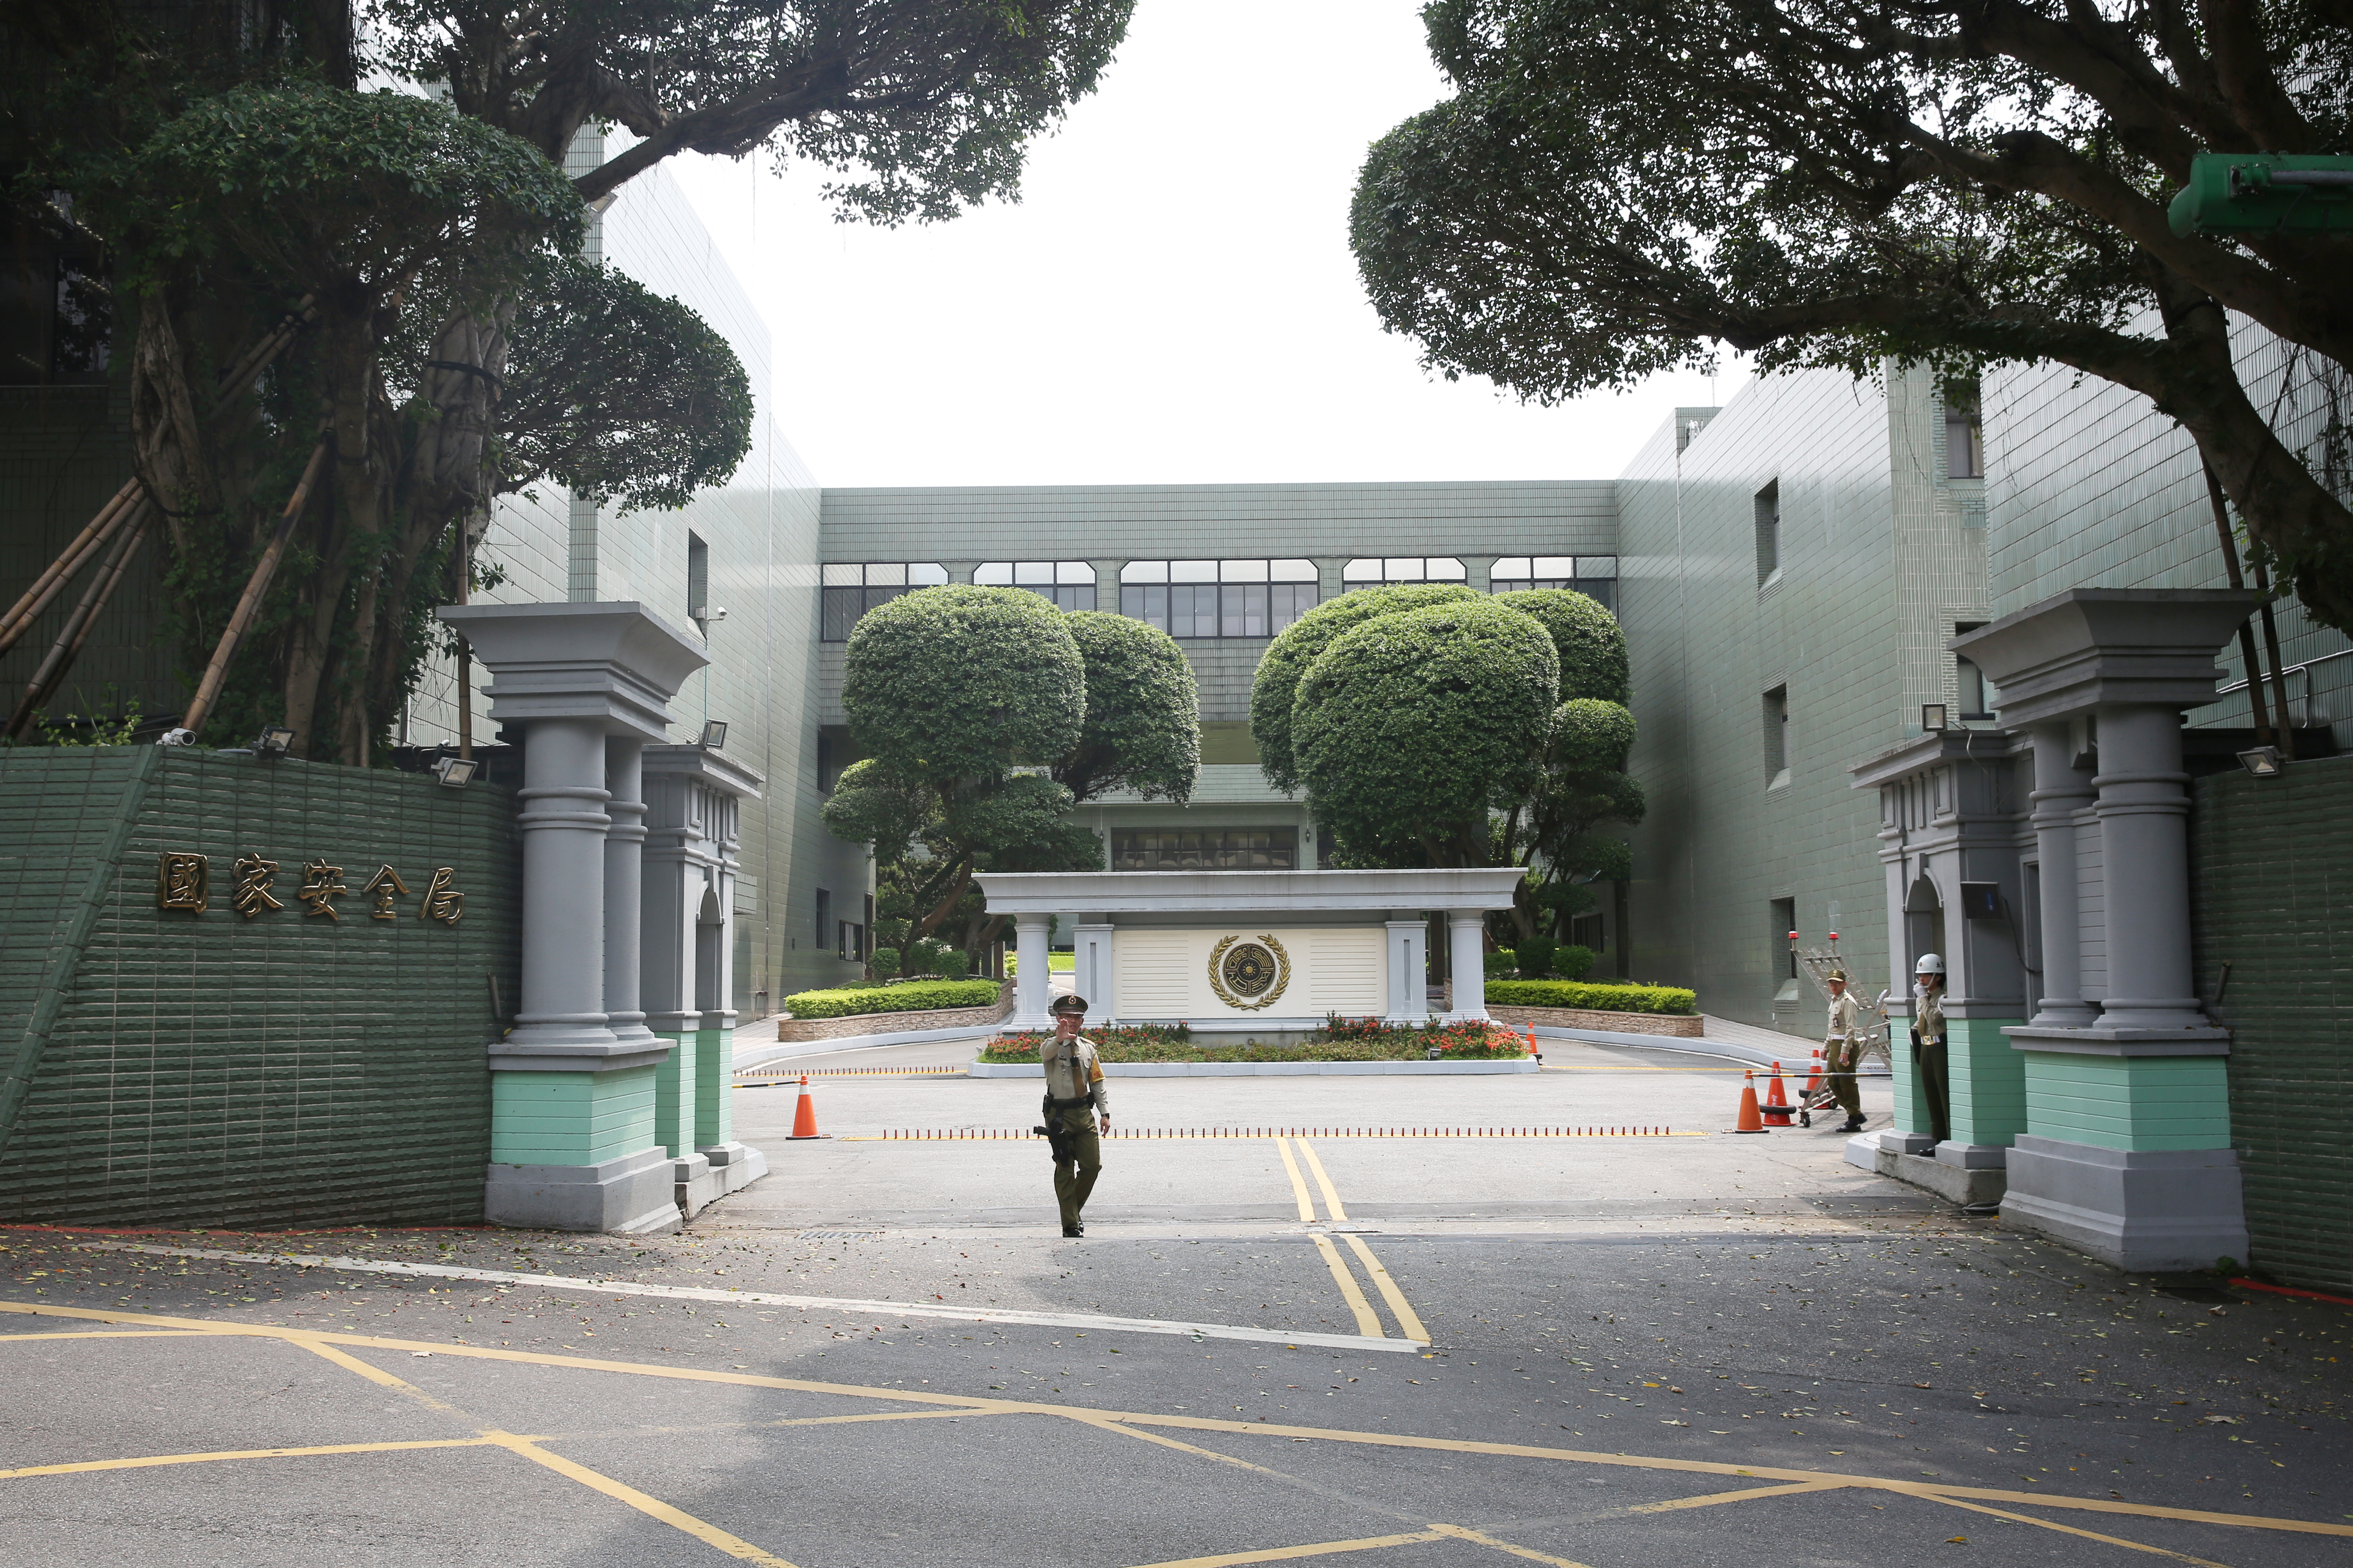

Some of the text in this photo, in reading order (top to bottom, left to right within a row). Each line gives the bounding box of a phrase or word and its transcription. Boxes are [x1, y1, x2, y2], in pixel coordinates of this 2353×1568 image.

[158, 852, 464, 924] 國家安全局
